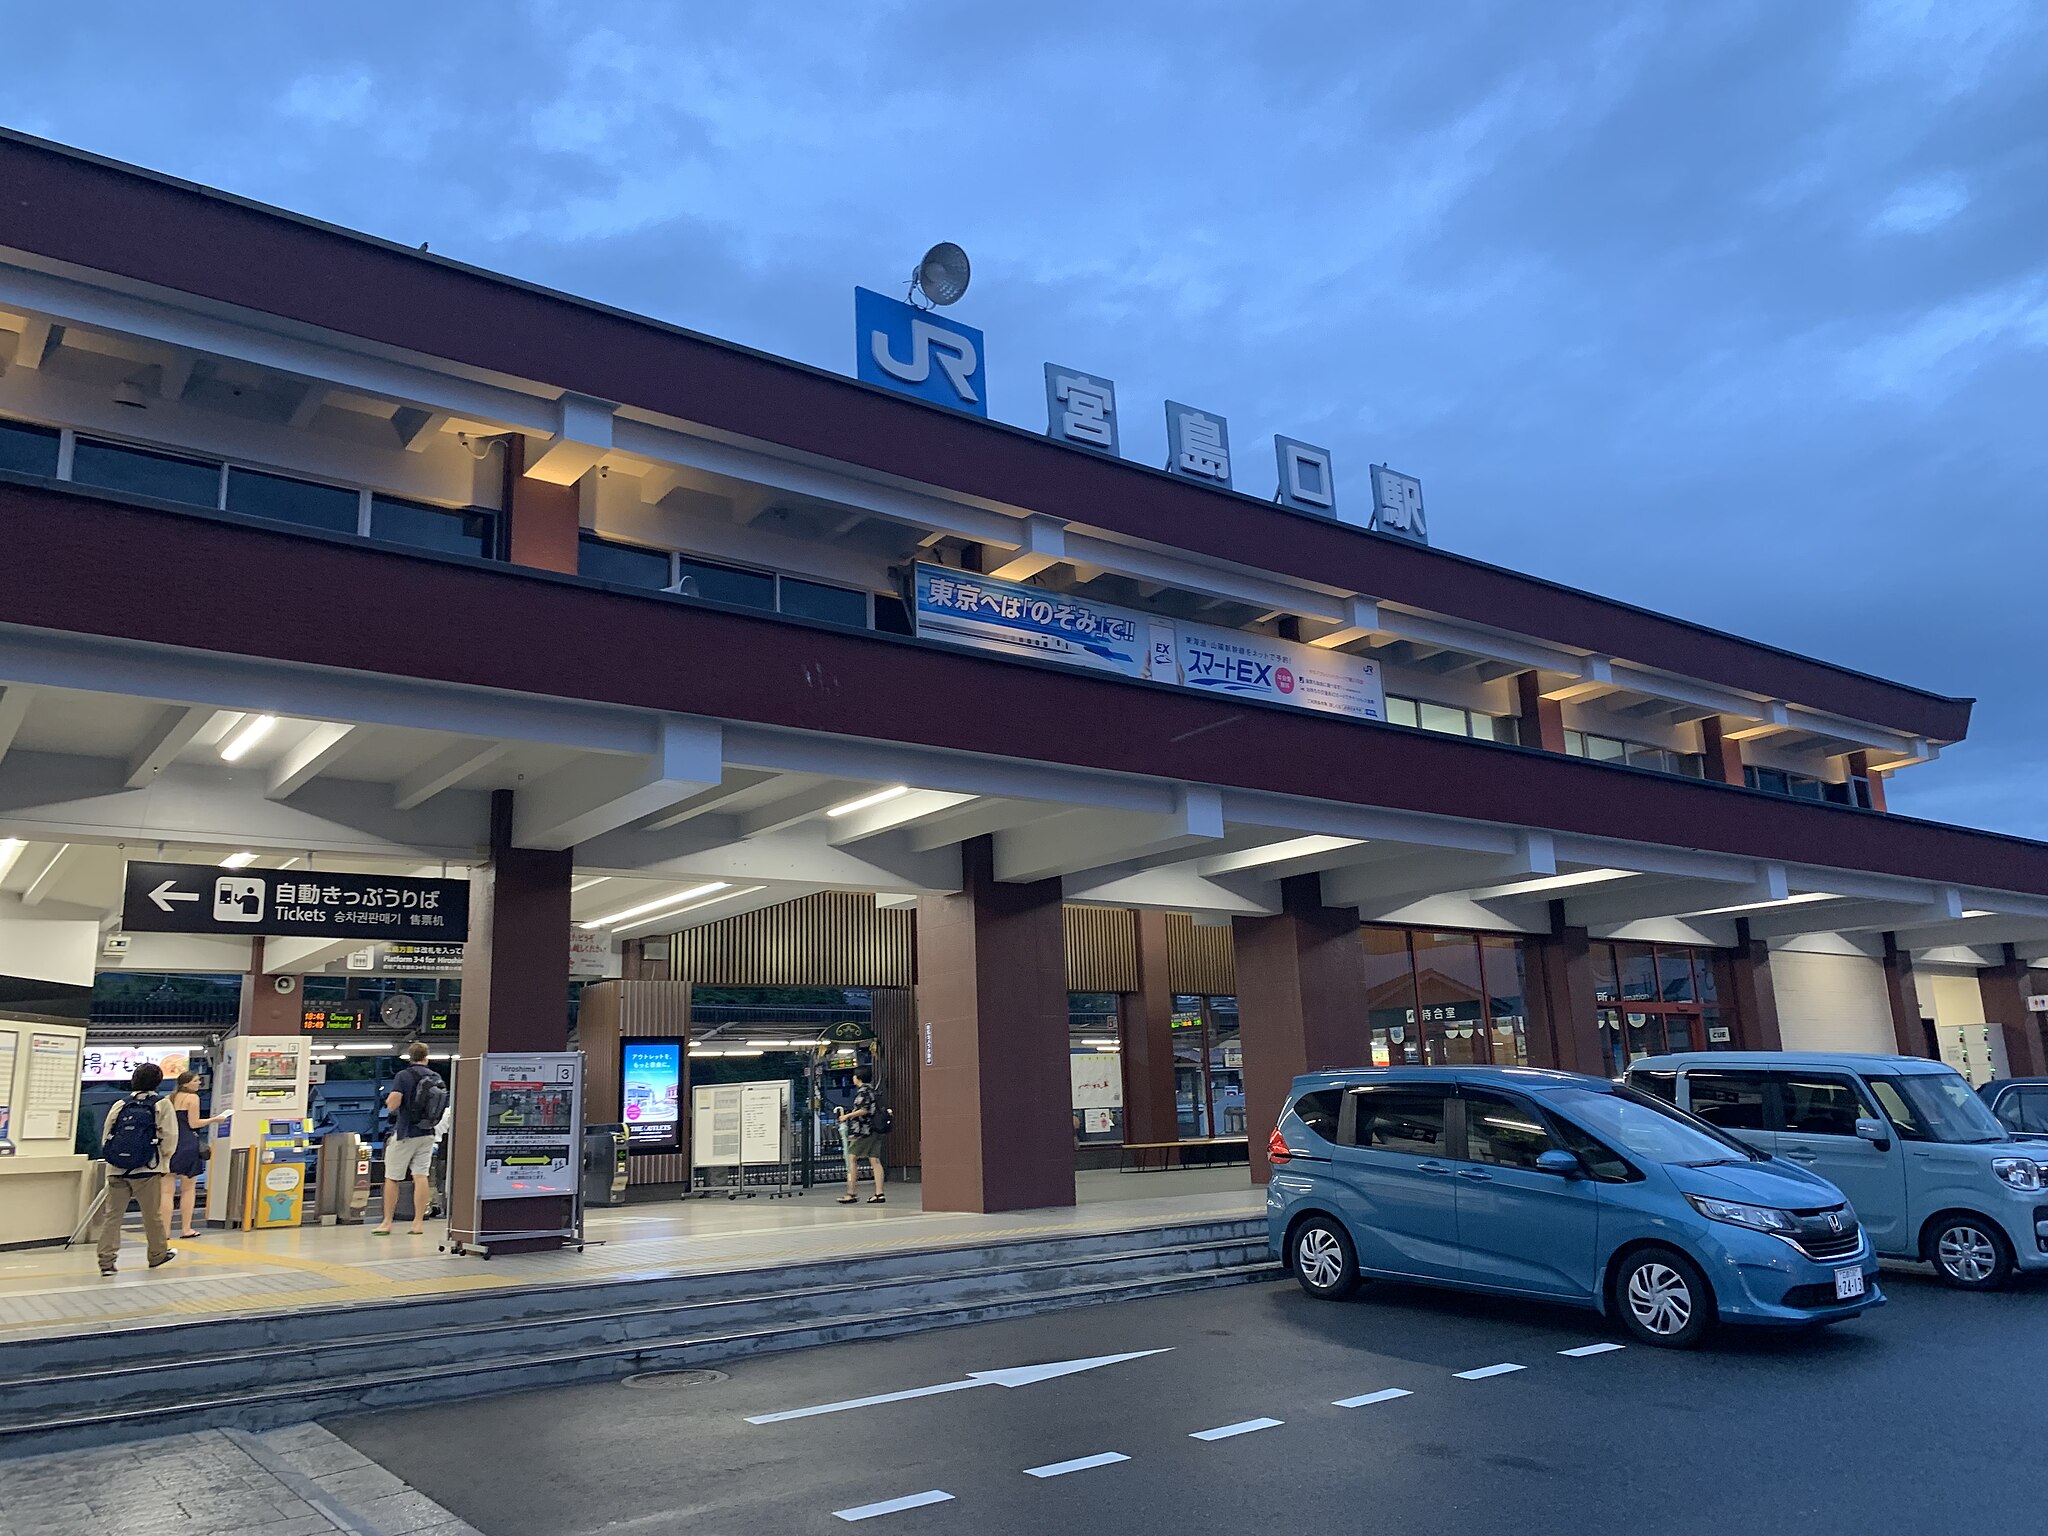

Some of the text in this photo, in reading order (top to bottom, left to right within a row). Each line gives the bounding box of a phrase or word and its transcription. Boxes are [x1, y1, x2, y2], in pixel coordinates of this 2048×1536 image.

[870, 319, 980, 402] JR
[1056, 374, 1428, 536] 宮島口駅
[1156, 642, 1170, 654] EX
[1188, 649, 1273, 687] スマートEX
[1363, 665, 1374, 674] JR
[275, 882, 441, 909] 自動きっぷうりば
[275, 906, 445, 927] Tickets 승차권판매기 售票机
[383, 955, 413, 963] Platform
[500, 1065, 536, 1073] Hiroshima
[561, 1069, 570, 1080] 3
